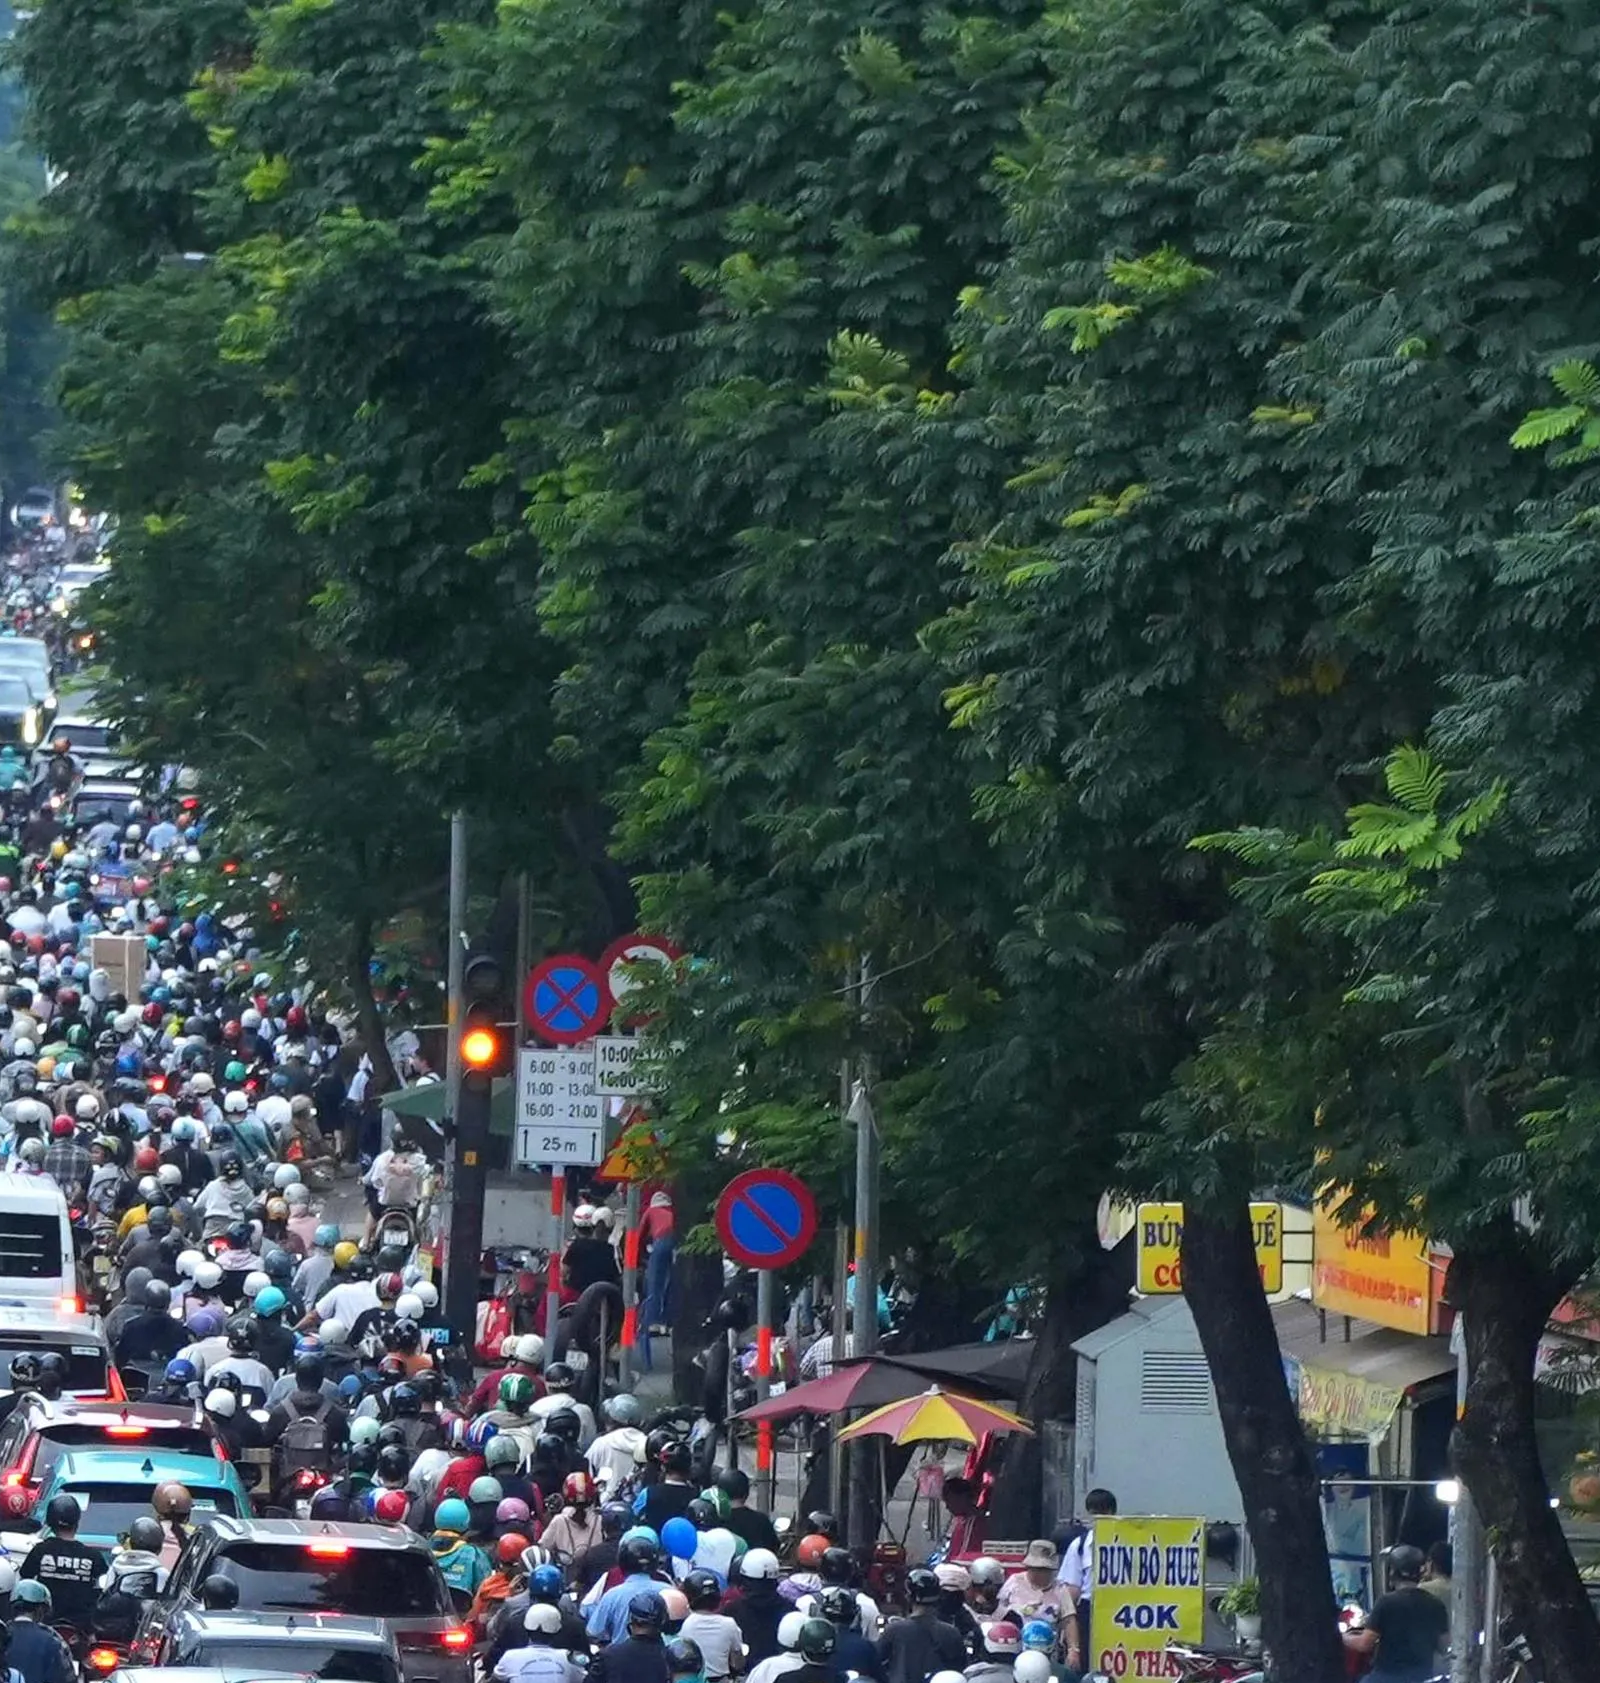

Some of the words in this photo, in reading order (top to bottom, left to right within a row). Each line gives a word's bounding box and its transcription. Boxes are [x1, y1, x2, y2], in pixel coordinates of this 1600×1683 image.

[542, 1137, 561, 1152] 25
[564, 1142, 577, 1153] m
[1097, 1534, 1134, 1586] BÚN
[1137, 1534, 1161, 1587] BÒ
[1164, 1526, 1201, 1587] HUẾ
[1113, 1605, 1180, 1629] 40K
[1100, 1642, 1128, 1677] CÔ
